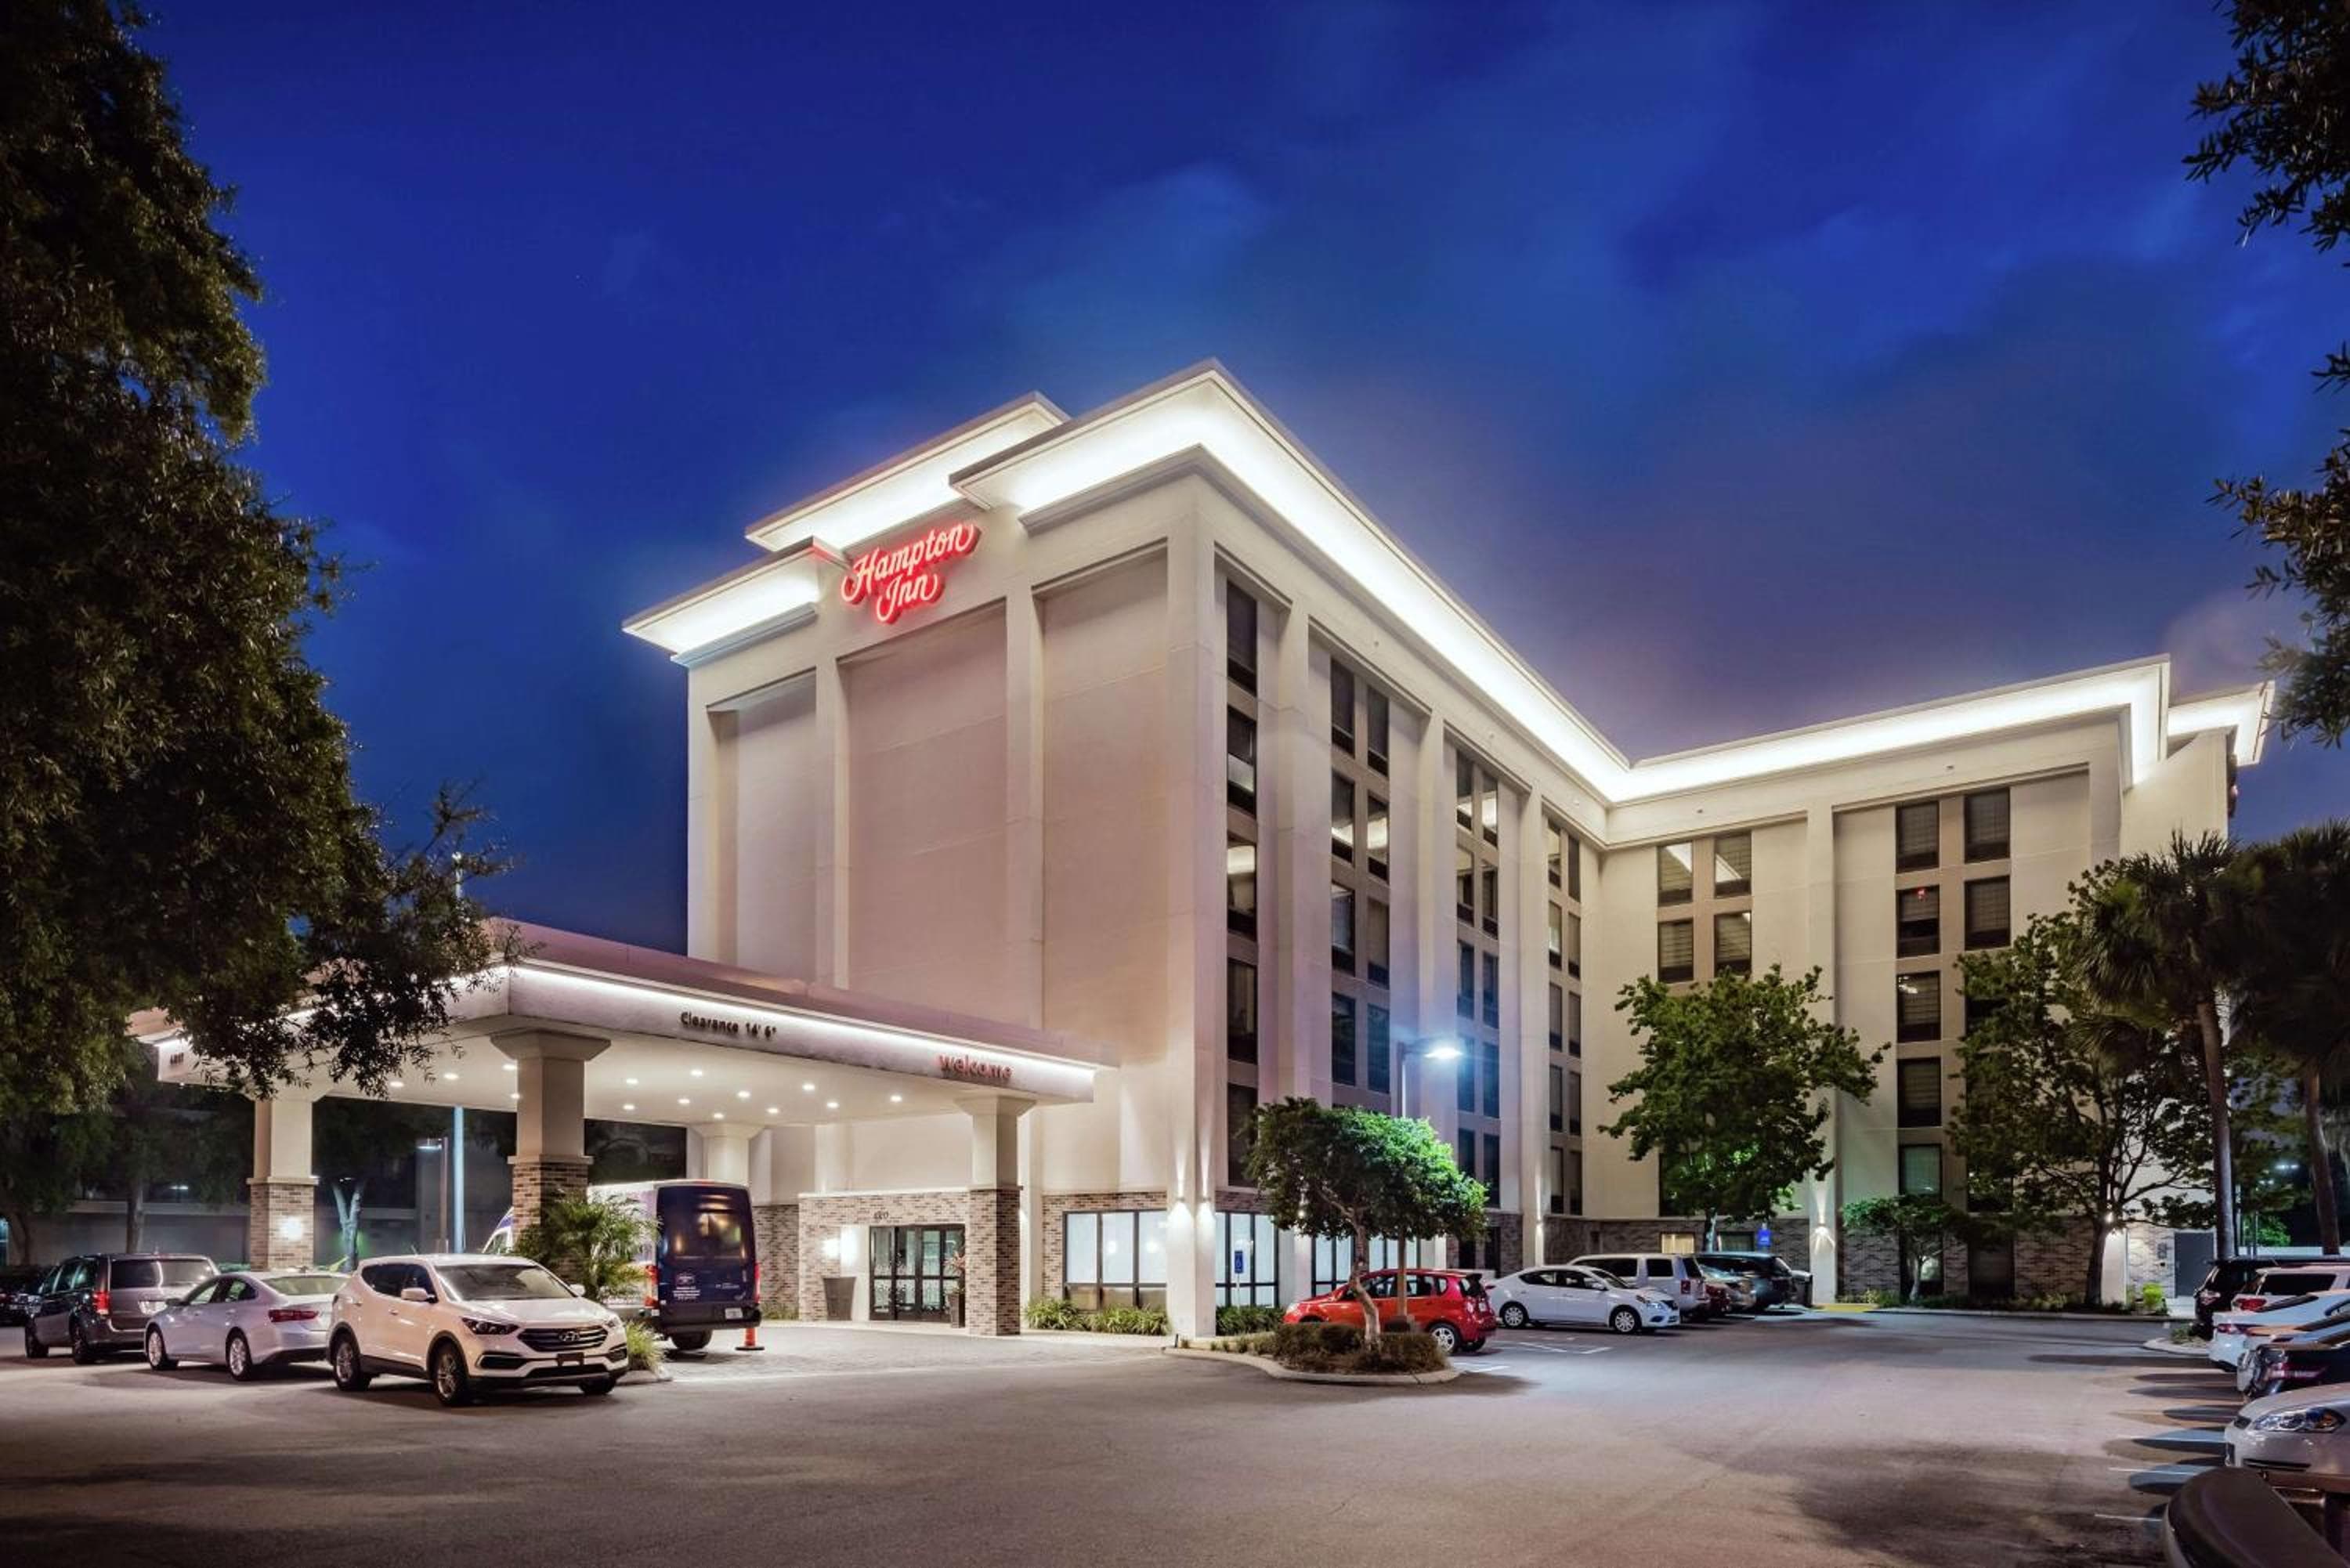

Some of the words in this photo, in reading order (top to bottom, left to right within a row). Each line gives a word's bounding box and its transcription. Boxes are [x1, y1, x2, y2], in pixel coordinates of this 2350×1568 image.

[841, 523, 981, 604] Hampton
[876, 573, 945, 623] Inn
[681, 1011, 739, 1034] Clearance
